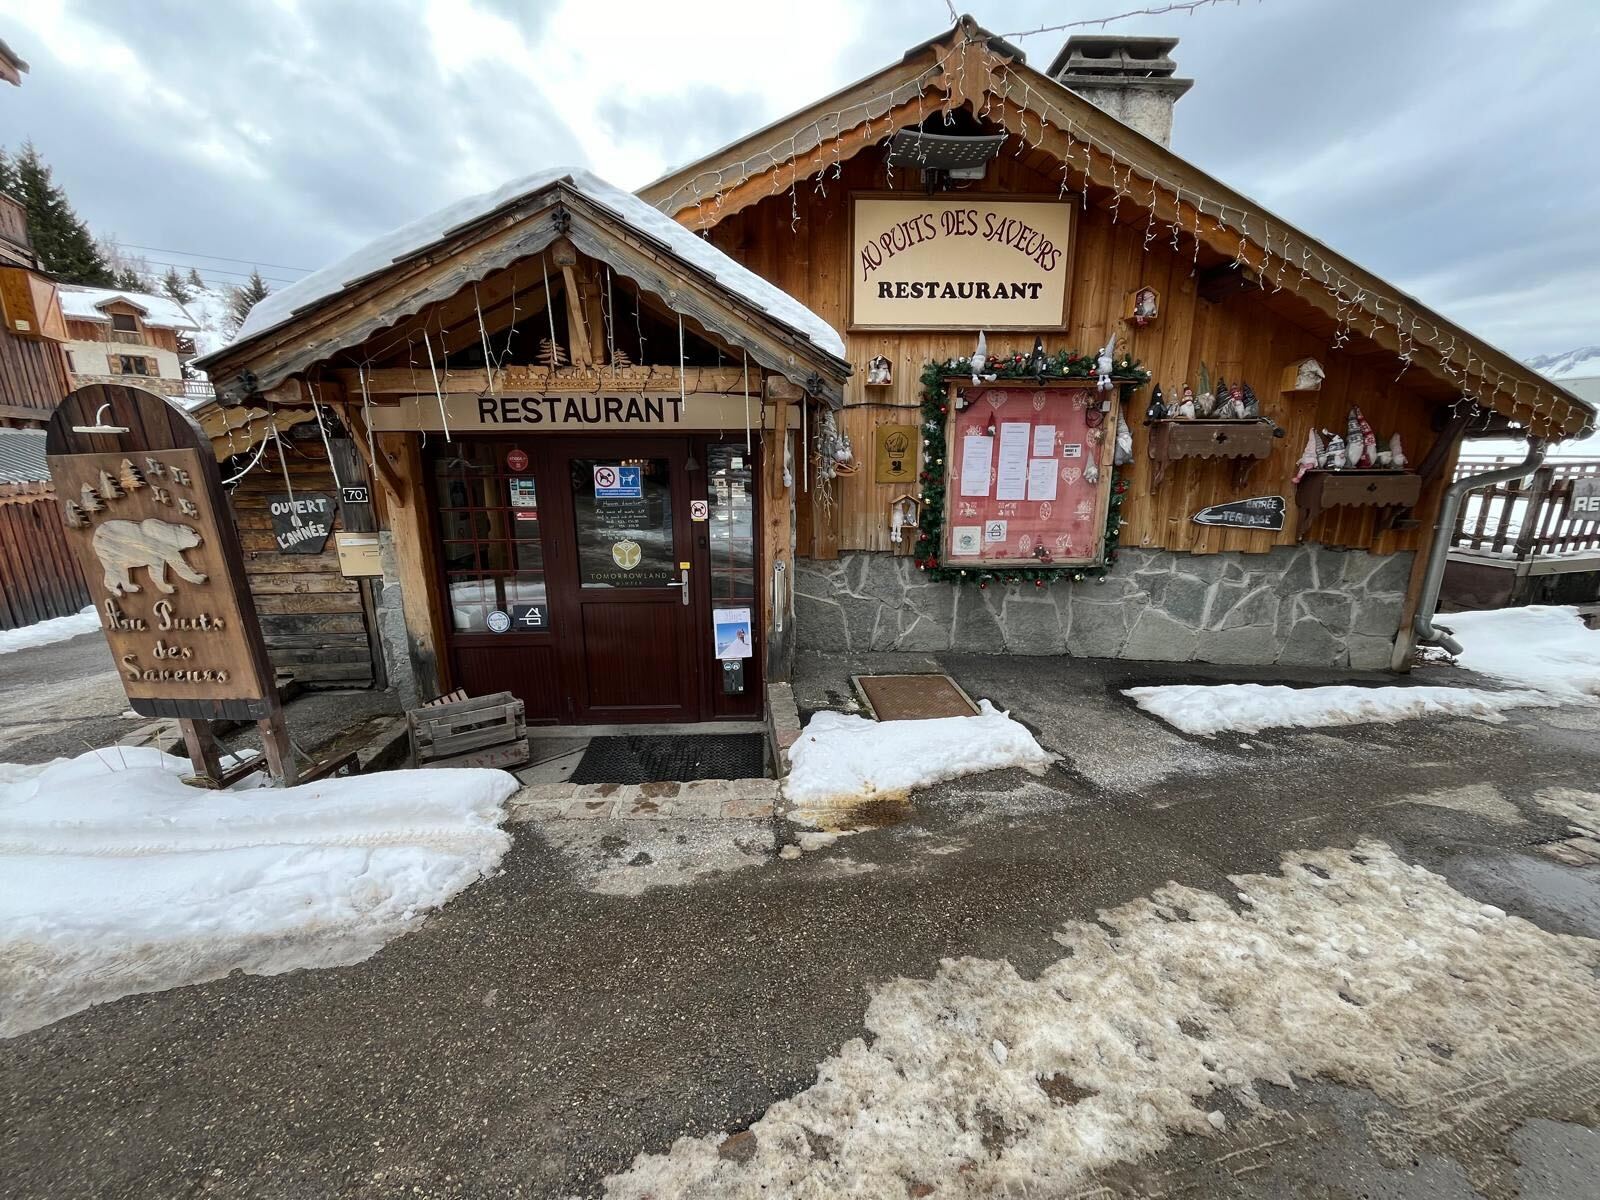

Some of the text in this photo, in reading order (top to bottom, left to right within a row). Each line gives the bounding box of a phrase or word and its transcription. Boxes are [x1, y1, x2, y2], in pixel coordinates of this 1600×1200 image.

[861, 209, 1062, 282] AU PUITS DES SAVEURS
[877, 281, 1042, 299] RESTAURANT
[478, 397, 683, 423] RESTAURANT
[271, 499, 326, 515] OUVERT
[348, 490, 362, 500] 70
[277, 521, 328, 549] L'ANNÉE
[105, 598, 225, 631] Au Puits
[153, 640, 193, 660] des
[122, 654, 229, 684] Saveurs
